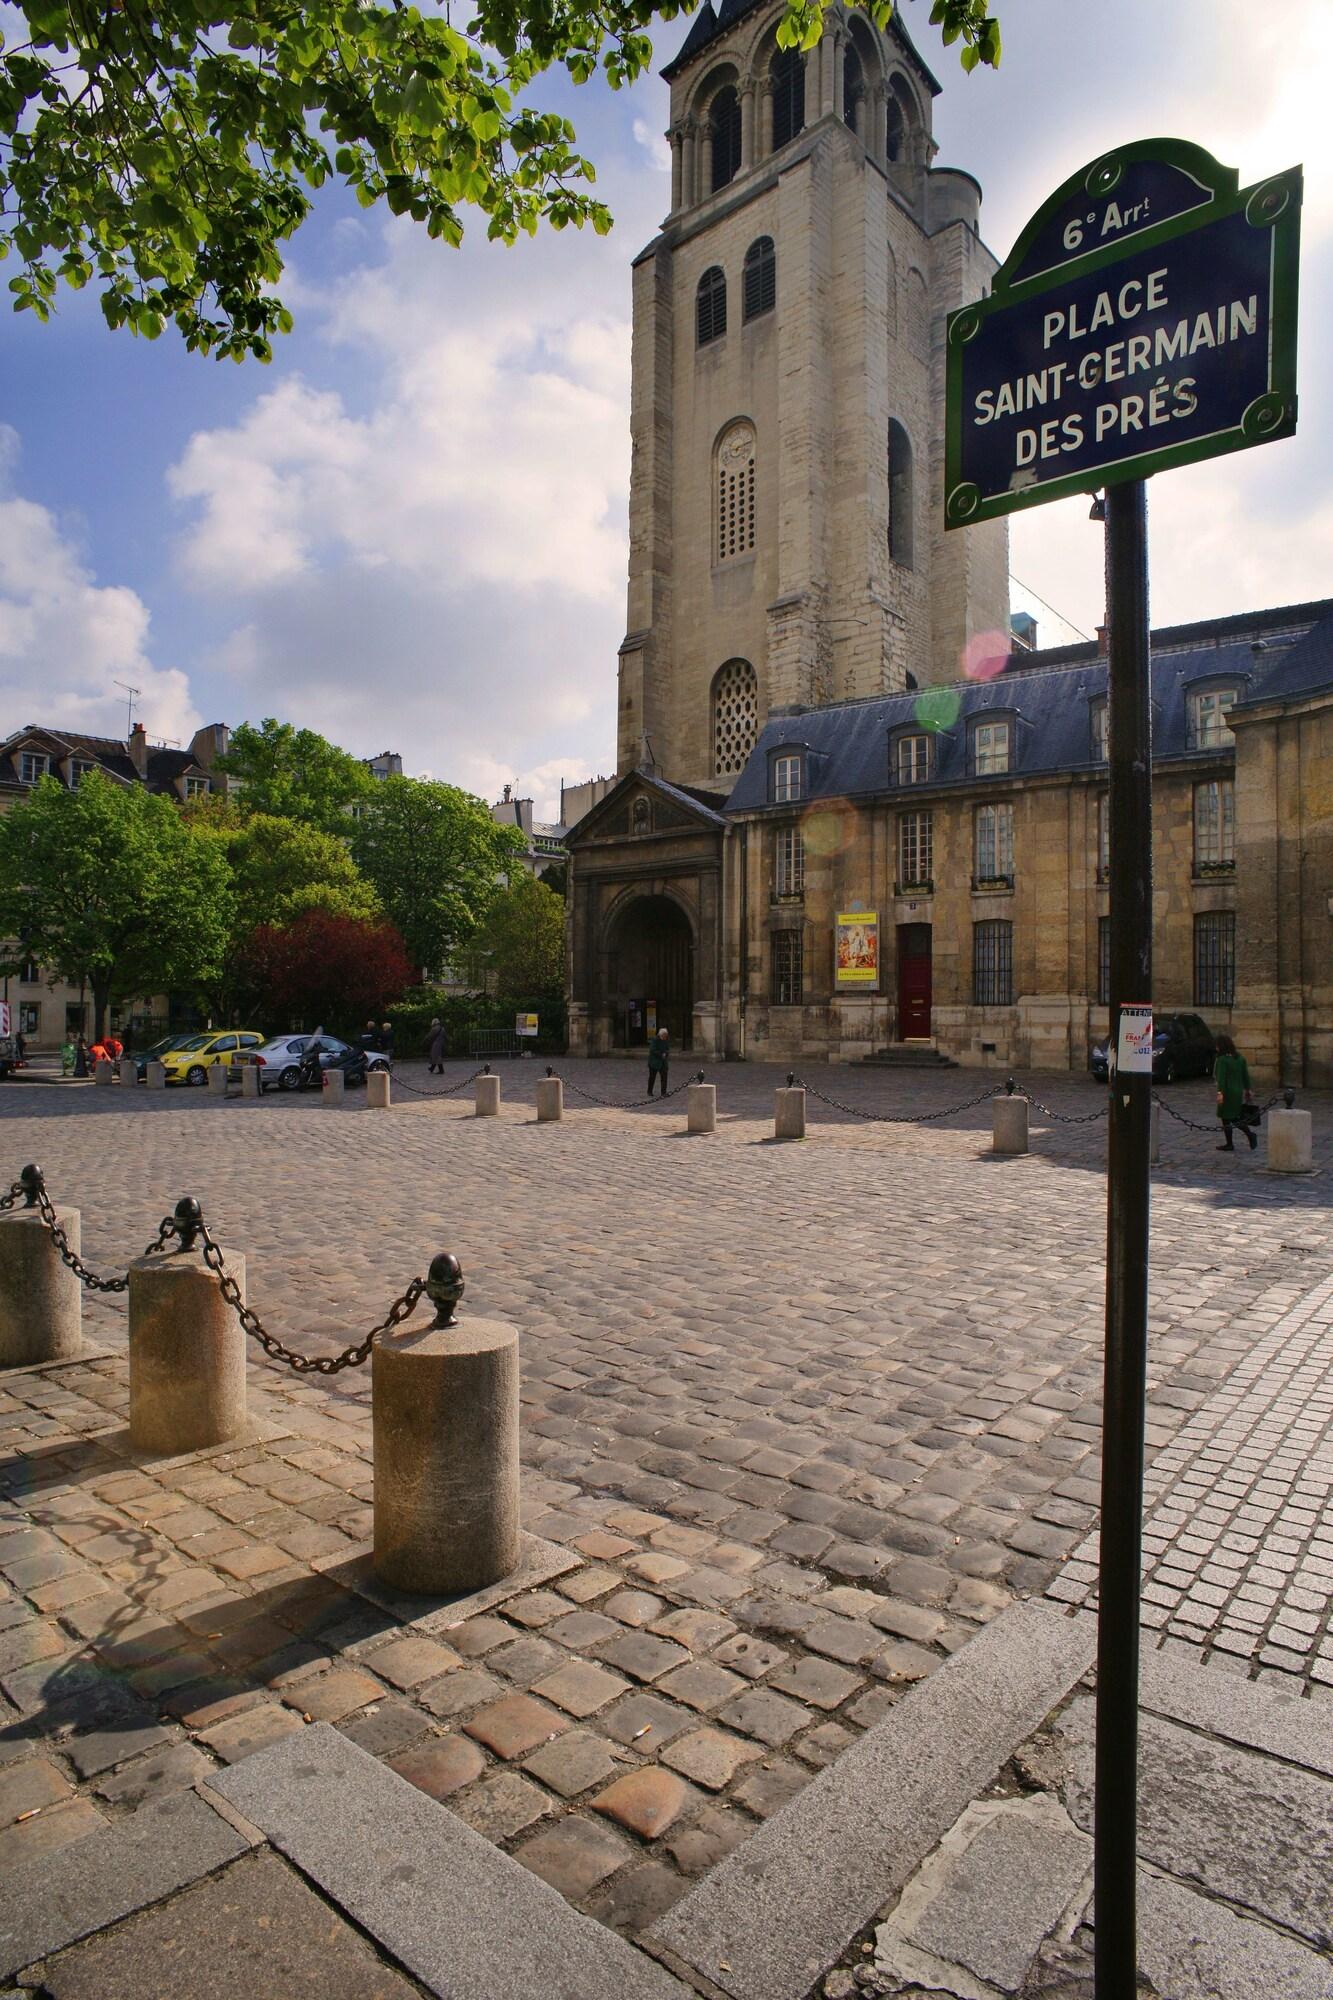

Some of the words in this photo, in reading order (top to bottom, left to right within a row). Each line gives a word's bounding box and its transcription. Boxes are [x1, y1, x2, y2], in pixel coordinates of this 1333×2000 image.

[1043, 268, 1168, 349] PLACE
[974, 294, 1257, 426] SAINT-GERMAIN
[1016, 413, 1084, 467] DES
[1096, 376, 1198, 443] PRÉS
